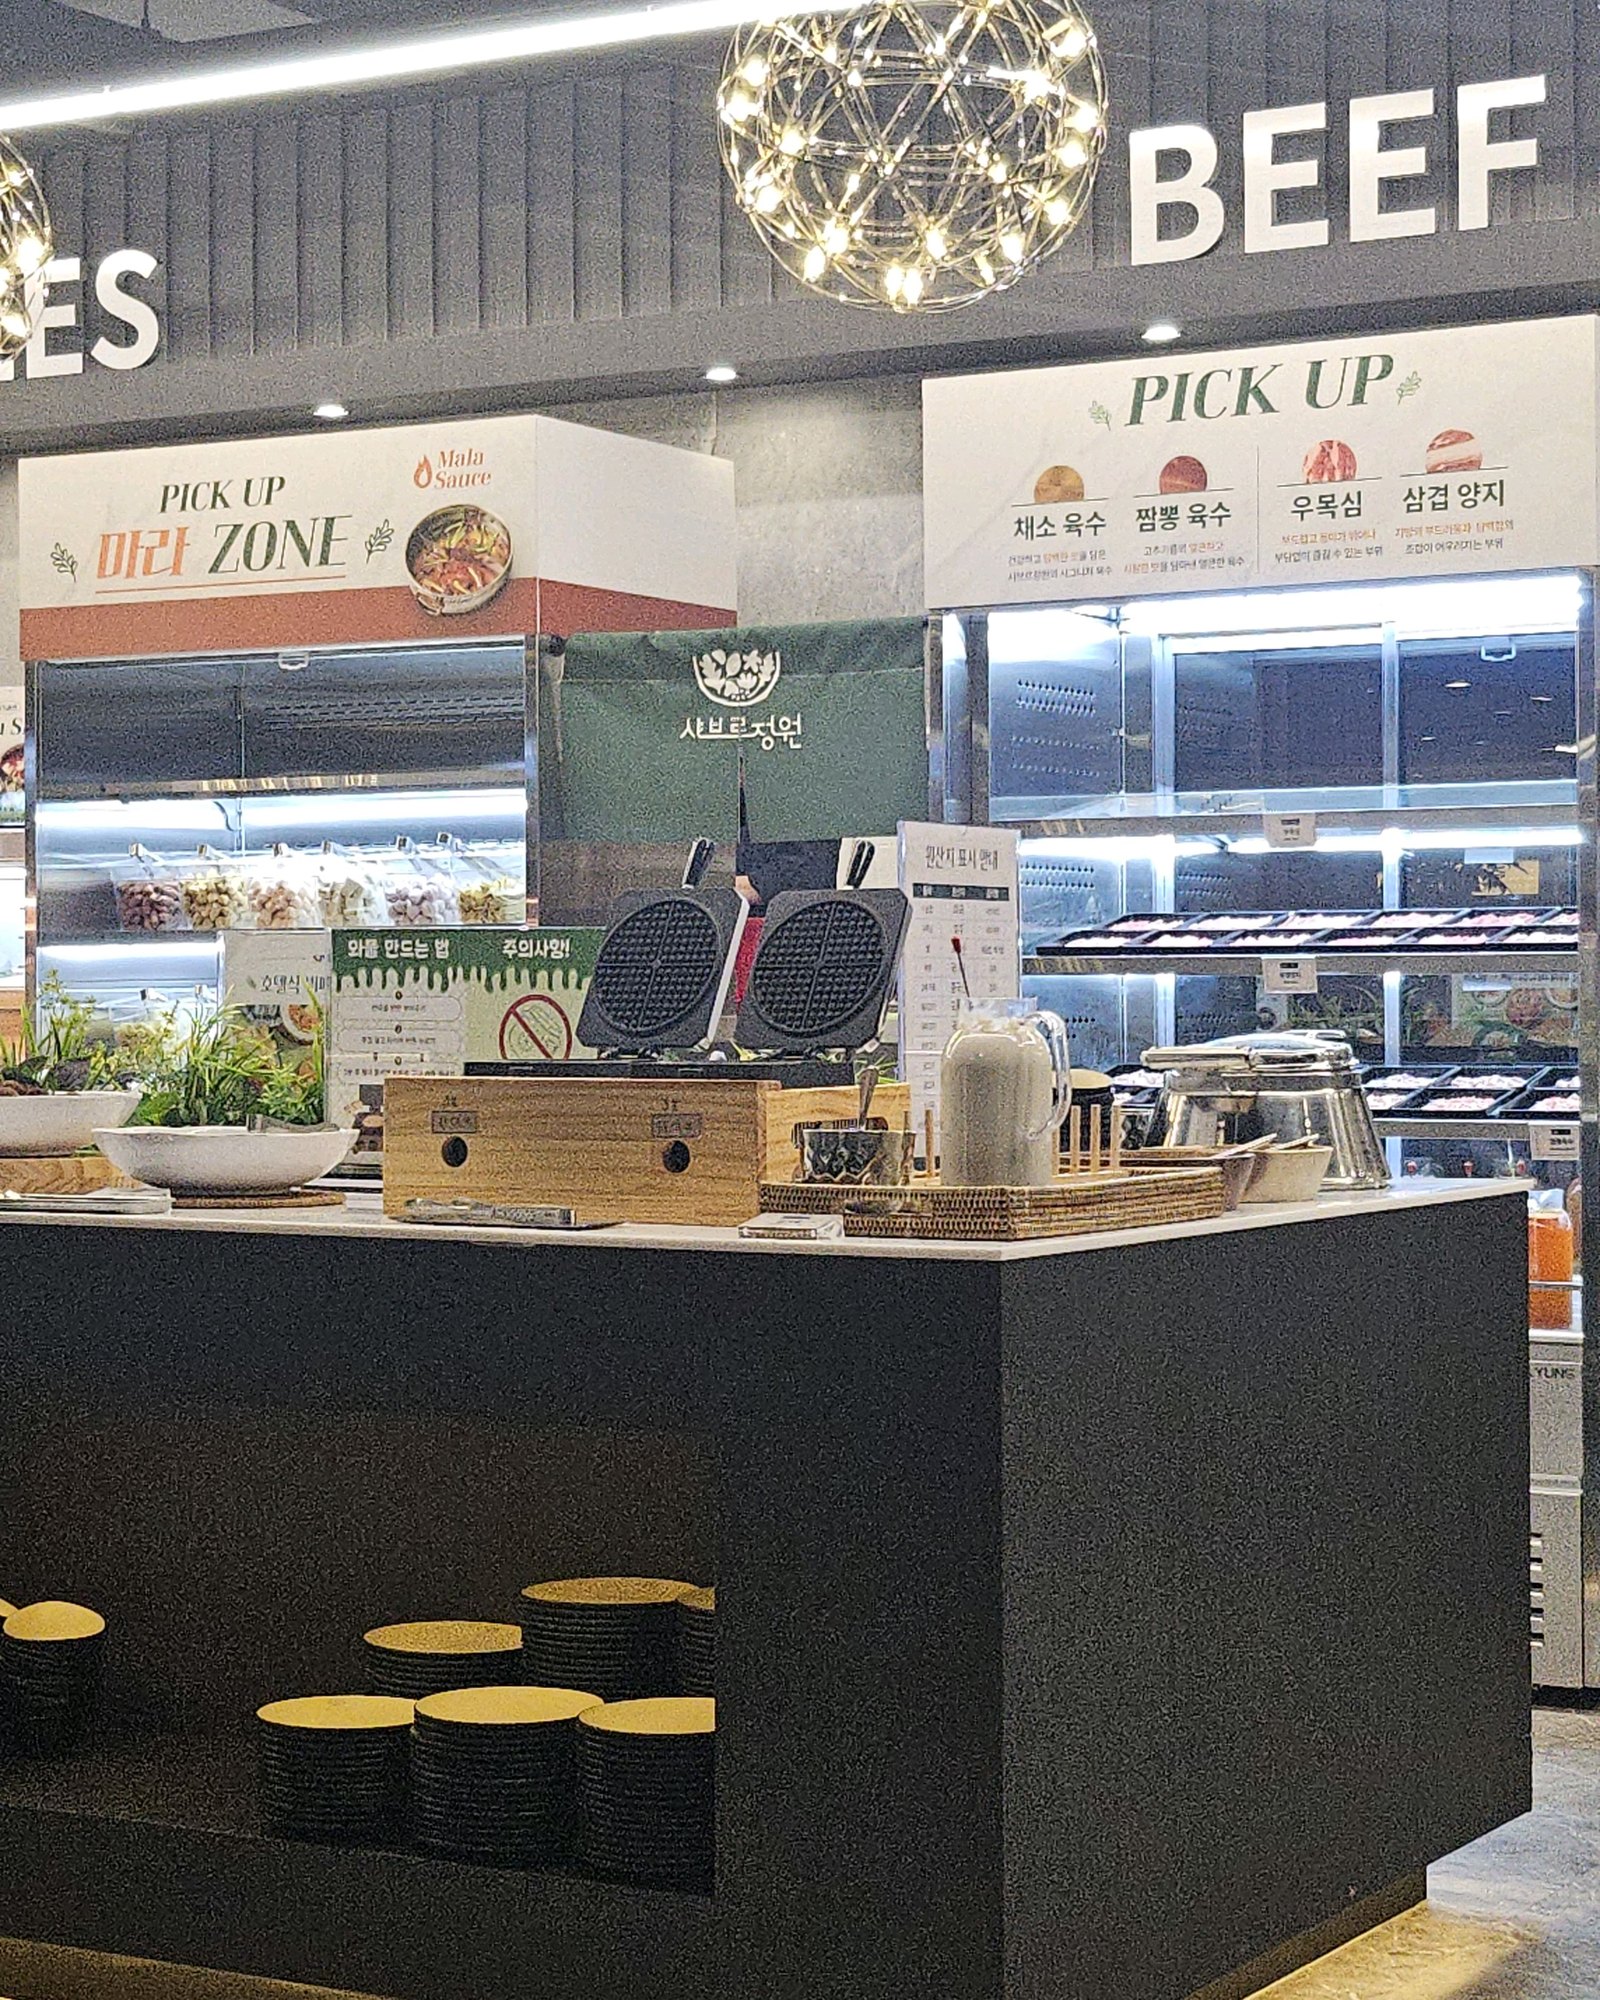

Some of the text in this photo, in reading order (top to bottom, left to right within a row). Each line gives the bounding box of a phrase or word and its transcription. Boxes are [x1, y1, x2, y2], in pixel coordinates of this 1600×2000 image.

[1129, 74, 1546, 266] BEEF
[0, 249, 159, 381] ES
[1124, 353, 1394, 427] PICK UP
[438, 448, 484, 469] Mala
[159, 476, 286, 513] PICK UP
[434, 471, 492, 489] Sauce
[1291, 490, 1362, 521] 우목심
[1403, 479, 1505, 513] 삼겹 양지
[1013, 511, 1107, 541] 채소 육수
[1136, 502, 1232, 533] 짬뽕 육수
[97, 515, 353, 579] 마라 ZONE
[925, 845, 954, 869] 원산지
[958, 848, 976, 869] 표시
[384, 938, 429, 959] 만드는
[434, 937, 450, 959] 법
[502, 938, 570, 959] 주의사항!
